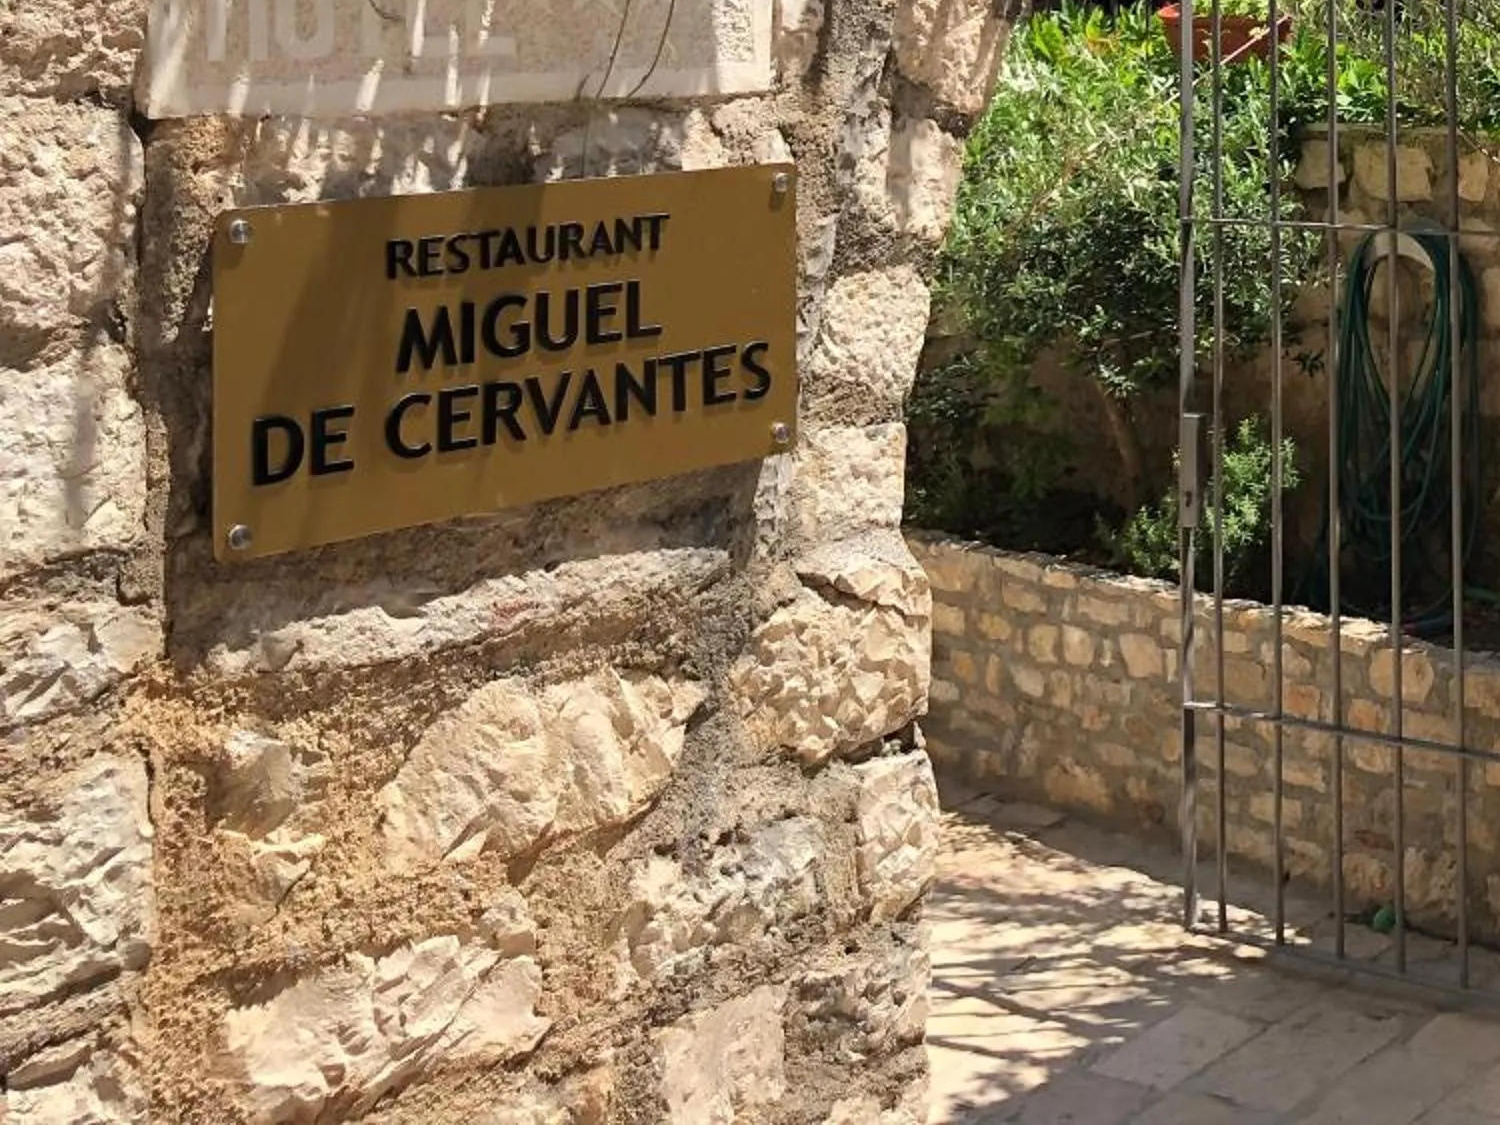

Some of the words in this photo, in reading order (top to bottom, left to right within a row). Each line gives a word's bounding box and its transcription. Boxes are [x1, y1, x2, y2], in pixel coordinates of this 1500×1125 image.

[386, 213, 671, 278] RESTAURANT
[396, 279, 662, 374] MIGUEL
[251, 405, 356, 487] DE
[385, 341, 773, 459] CERVANTES
